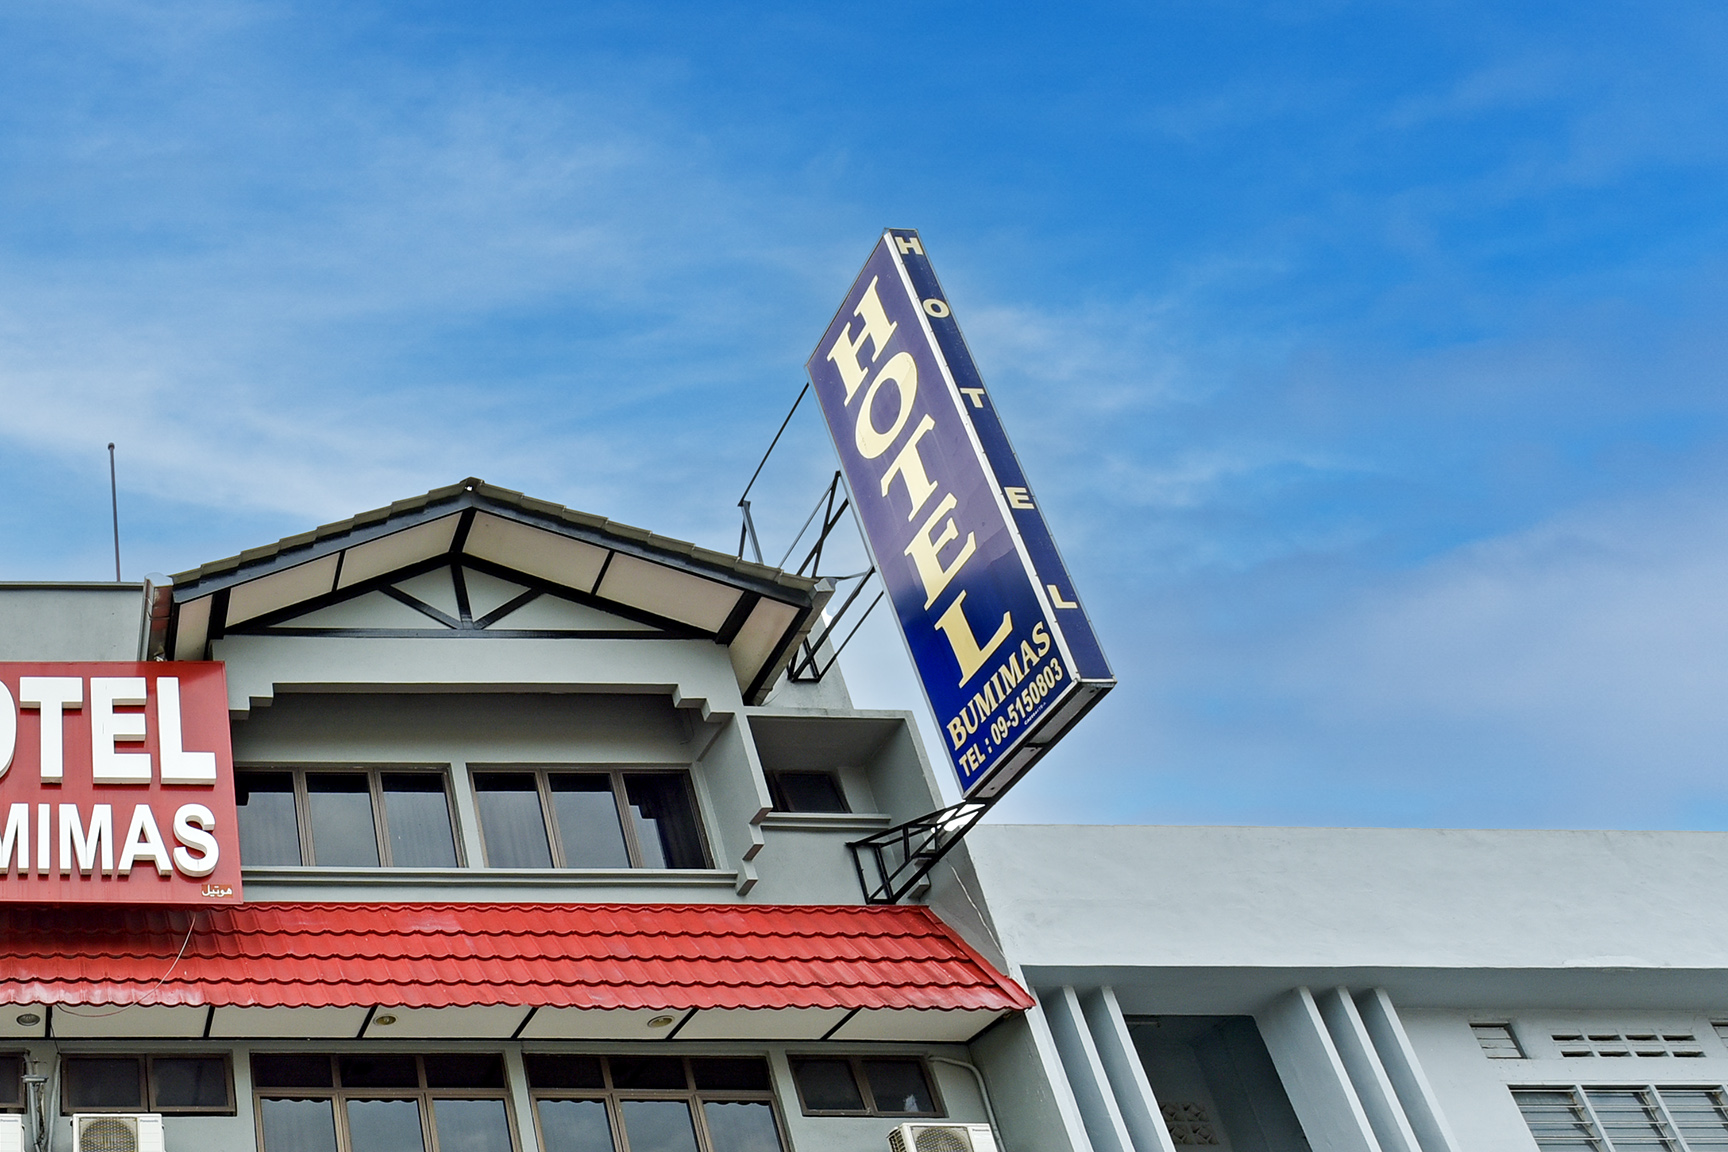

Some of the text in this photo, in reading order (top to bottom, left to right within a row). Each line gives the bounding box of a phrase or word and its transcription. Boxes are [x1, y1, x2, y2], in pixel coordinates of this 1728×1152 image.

[827, 275, 1012, 688] HOTEL
[896, 236, 1078, 608] HOTEL
[946, 621, 1051, 751] BUMIMAS
[958, 742, 986, 777] TEL
[990, 657, 1064, 746] 09-5150803
[201, 884, 233, 897] هوتيل
